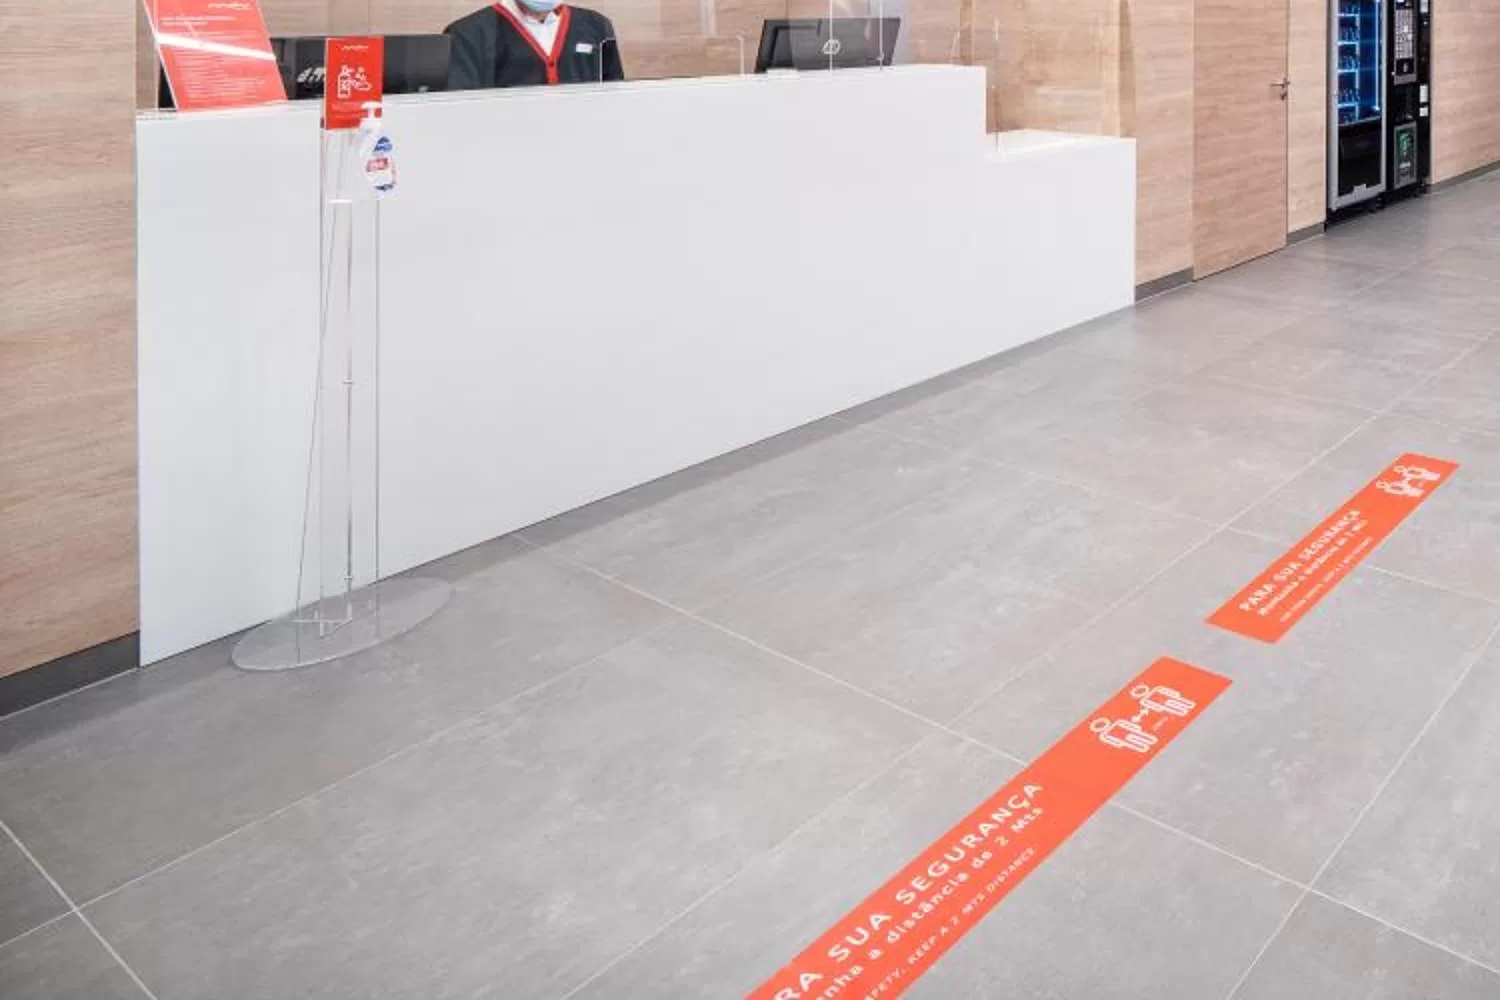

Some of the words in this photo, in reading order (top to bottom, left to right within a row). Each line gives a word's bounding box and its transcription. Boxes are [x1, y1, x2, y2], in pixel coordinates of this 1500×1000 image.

[828, 913, 892, 962] SUA
[895, 784, 1043, 904] SEGURANÇA
[868, 949, 882, 960] a
[971, 851, 993, 869] de
[995, 835, 1009, 847] 2
